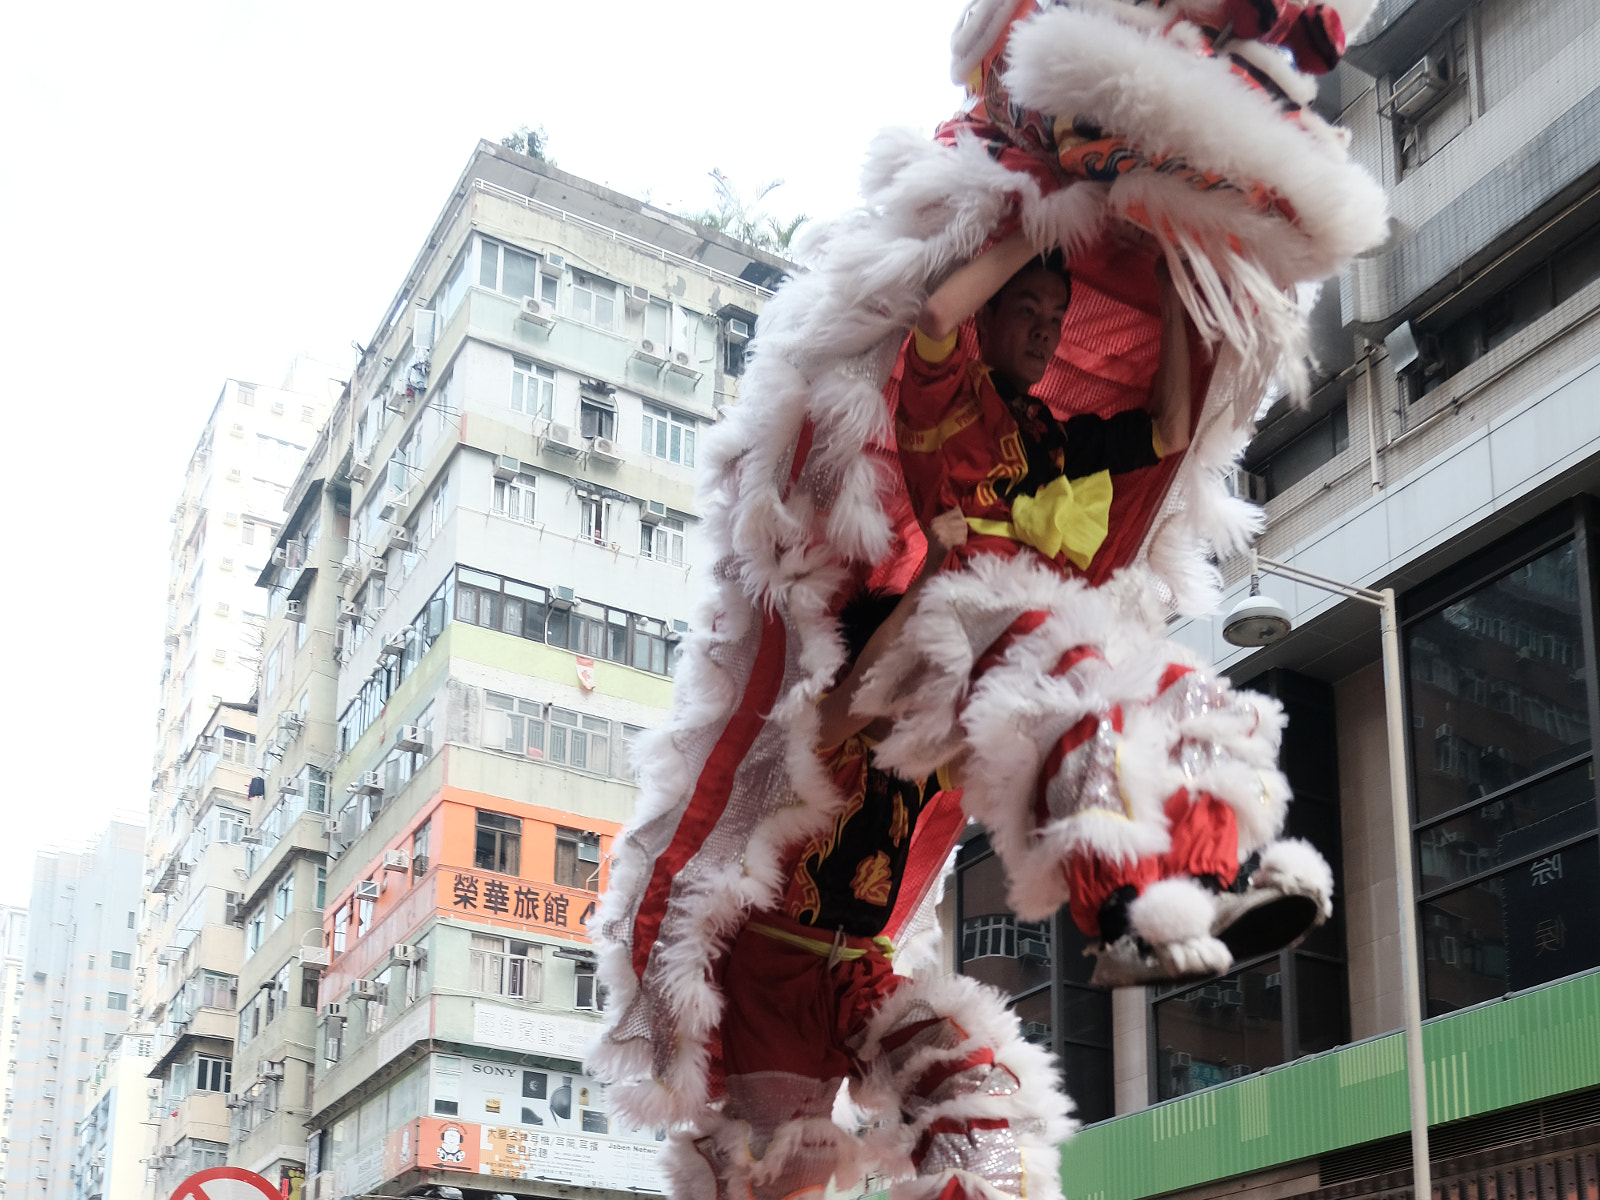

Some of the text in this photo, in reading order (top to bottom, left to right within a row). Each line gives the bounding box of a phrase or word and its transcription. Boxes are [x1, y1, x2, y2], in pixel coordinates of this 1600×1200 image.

[453, 873, 569, 927] 榮華旅館
[472, 1064, 516, 1078] SONY
